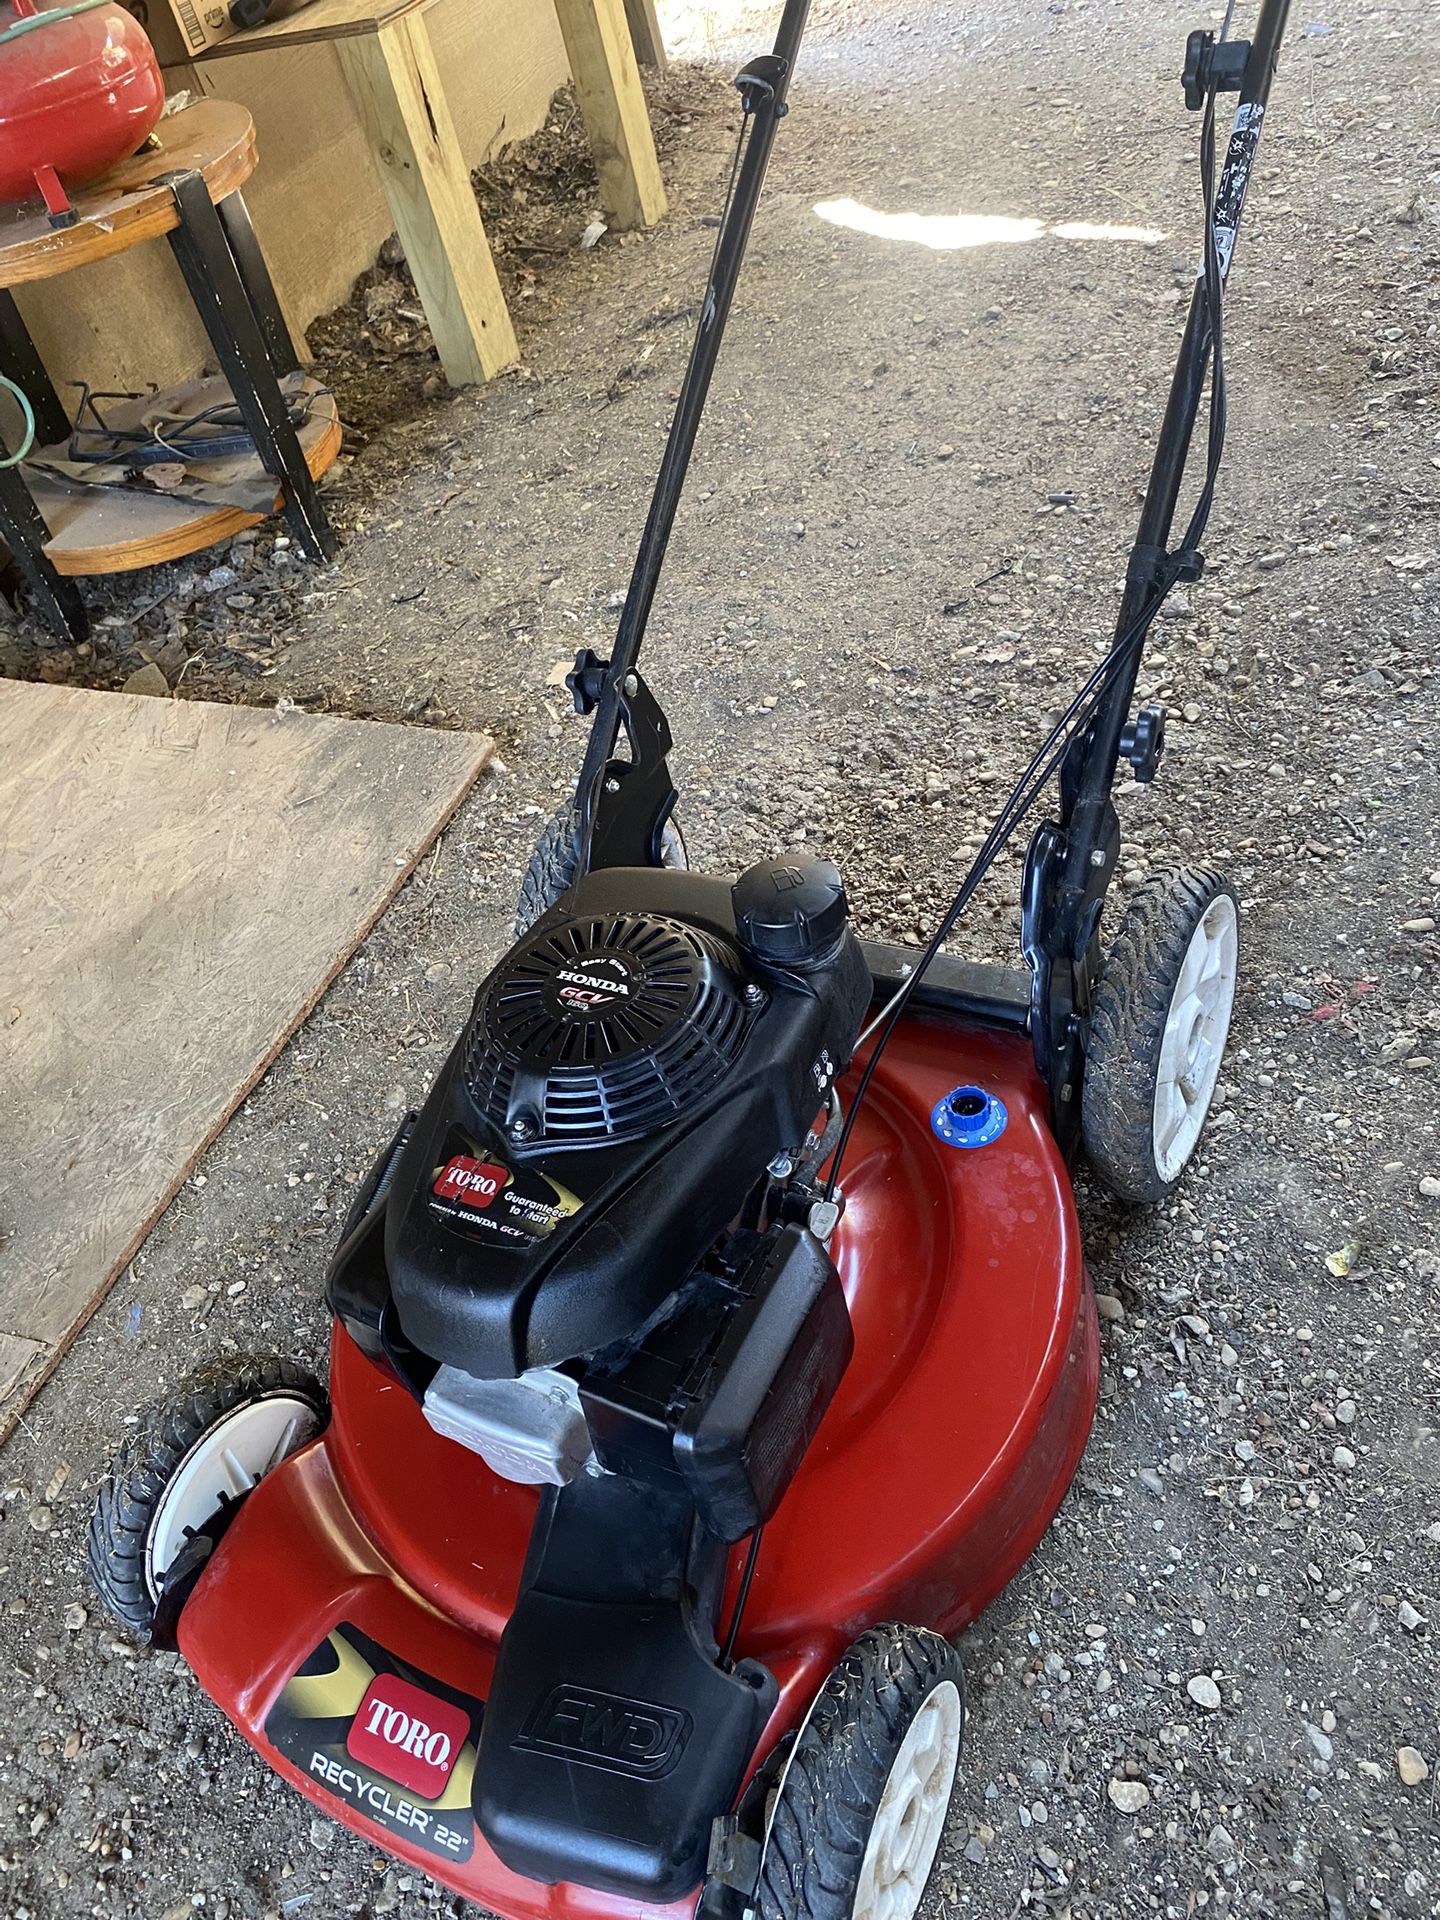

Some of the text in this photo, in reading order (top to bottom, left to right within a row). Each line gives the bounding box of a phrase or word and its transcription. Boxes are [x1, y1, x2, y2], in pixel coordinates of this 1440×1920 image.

[204, 6, 224, 24] prime
[556, 970, 629, 995] HONDA
[559, 986, 616, 1005] GCV
[445, 1166, 497, 1195] TORO
[504, 1191, 568, 1219] Guaranteed
[509, 1205, 520, 1216] to
[457, 1210, 498, 1230] HONDA
[500, 1225, 524, 1237] GCV
[364, 1698, 451, 1767] TORO
[550, 1698, 666, 1758] FWD
[309, 1751, 469, 1854] RECYCLER 22"
